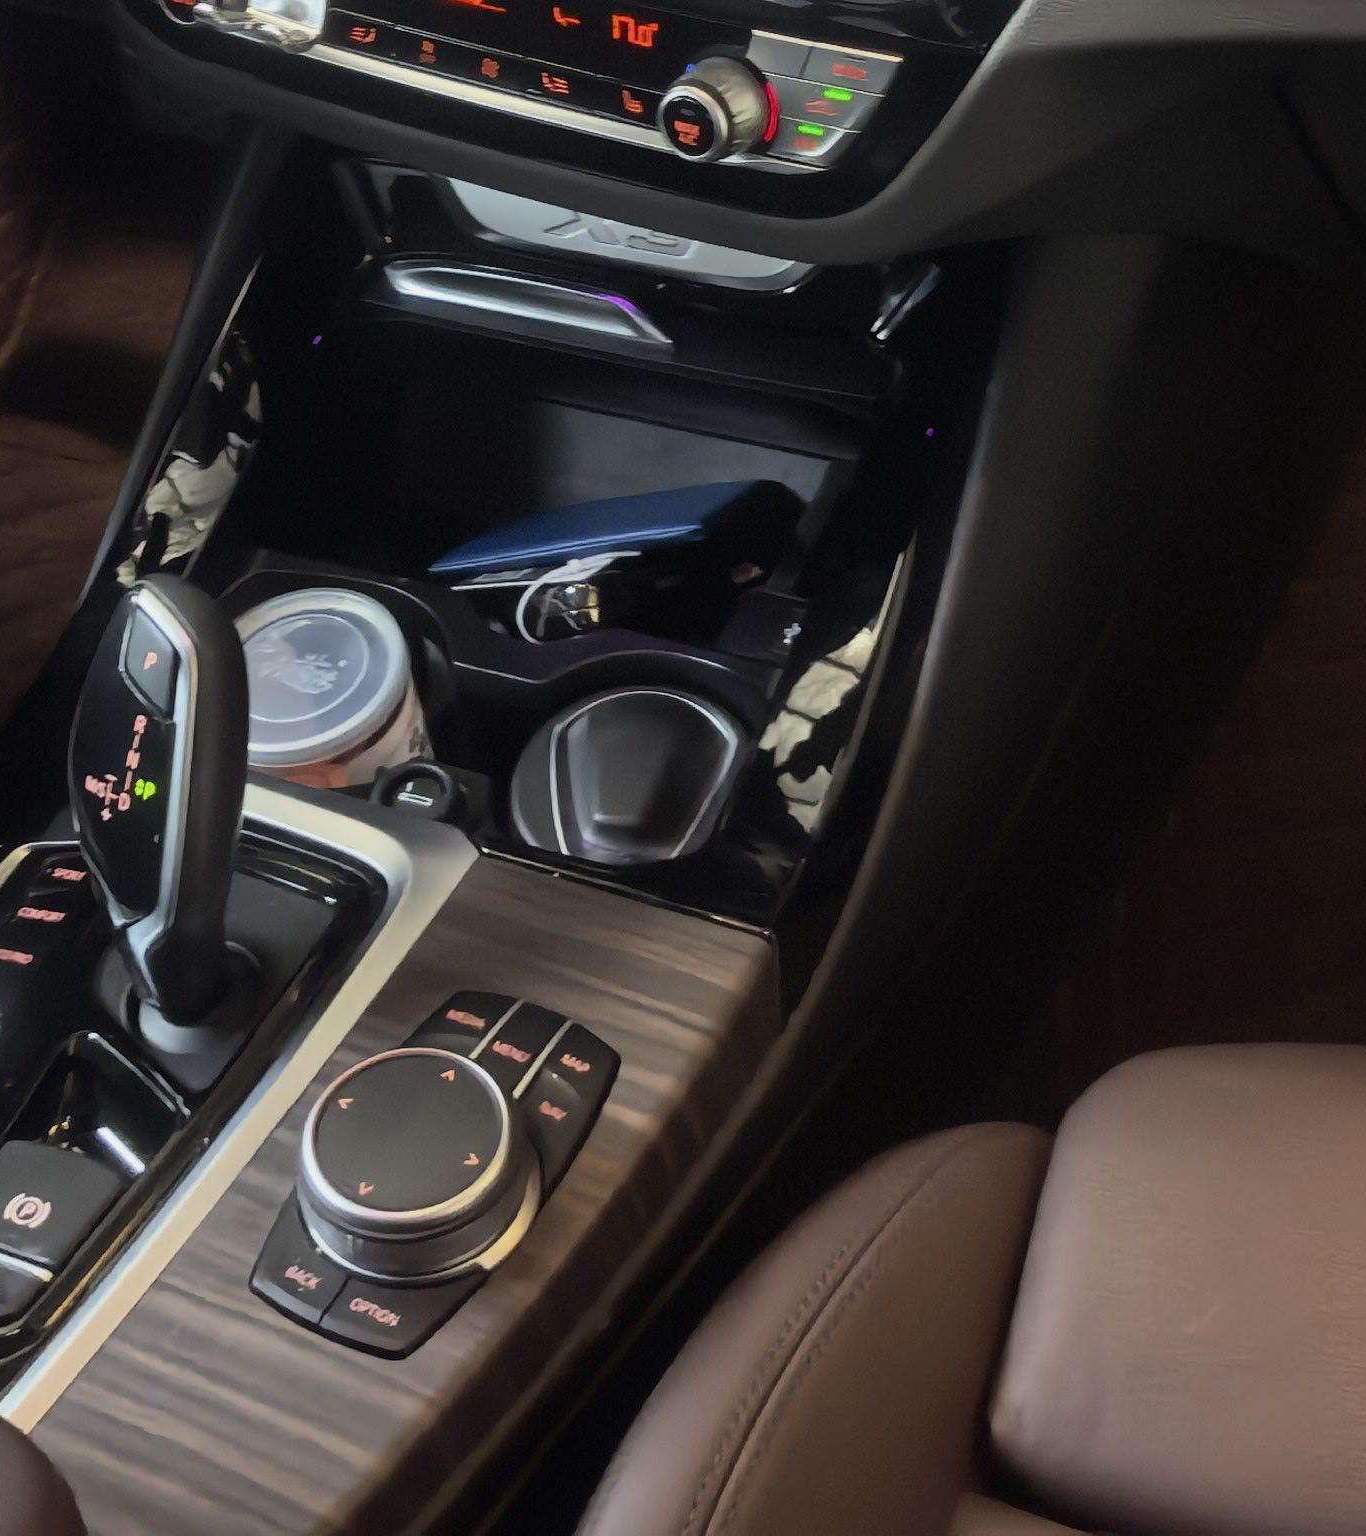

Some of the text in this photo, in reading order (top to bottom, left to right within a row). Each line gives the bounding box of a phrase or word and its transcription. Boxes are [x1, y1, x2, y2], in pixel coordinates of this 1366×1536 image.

[144, 652, 158, 670] P
[133, 714, 148, 735] R
[126, 749, 141, 770] N
[117, 792, 131, 811] D
[285, 1265, 323, 1291] BACK
[349, 1297, 401, 1326] OPTION
